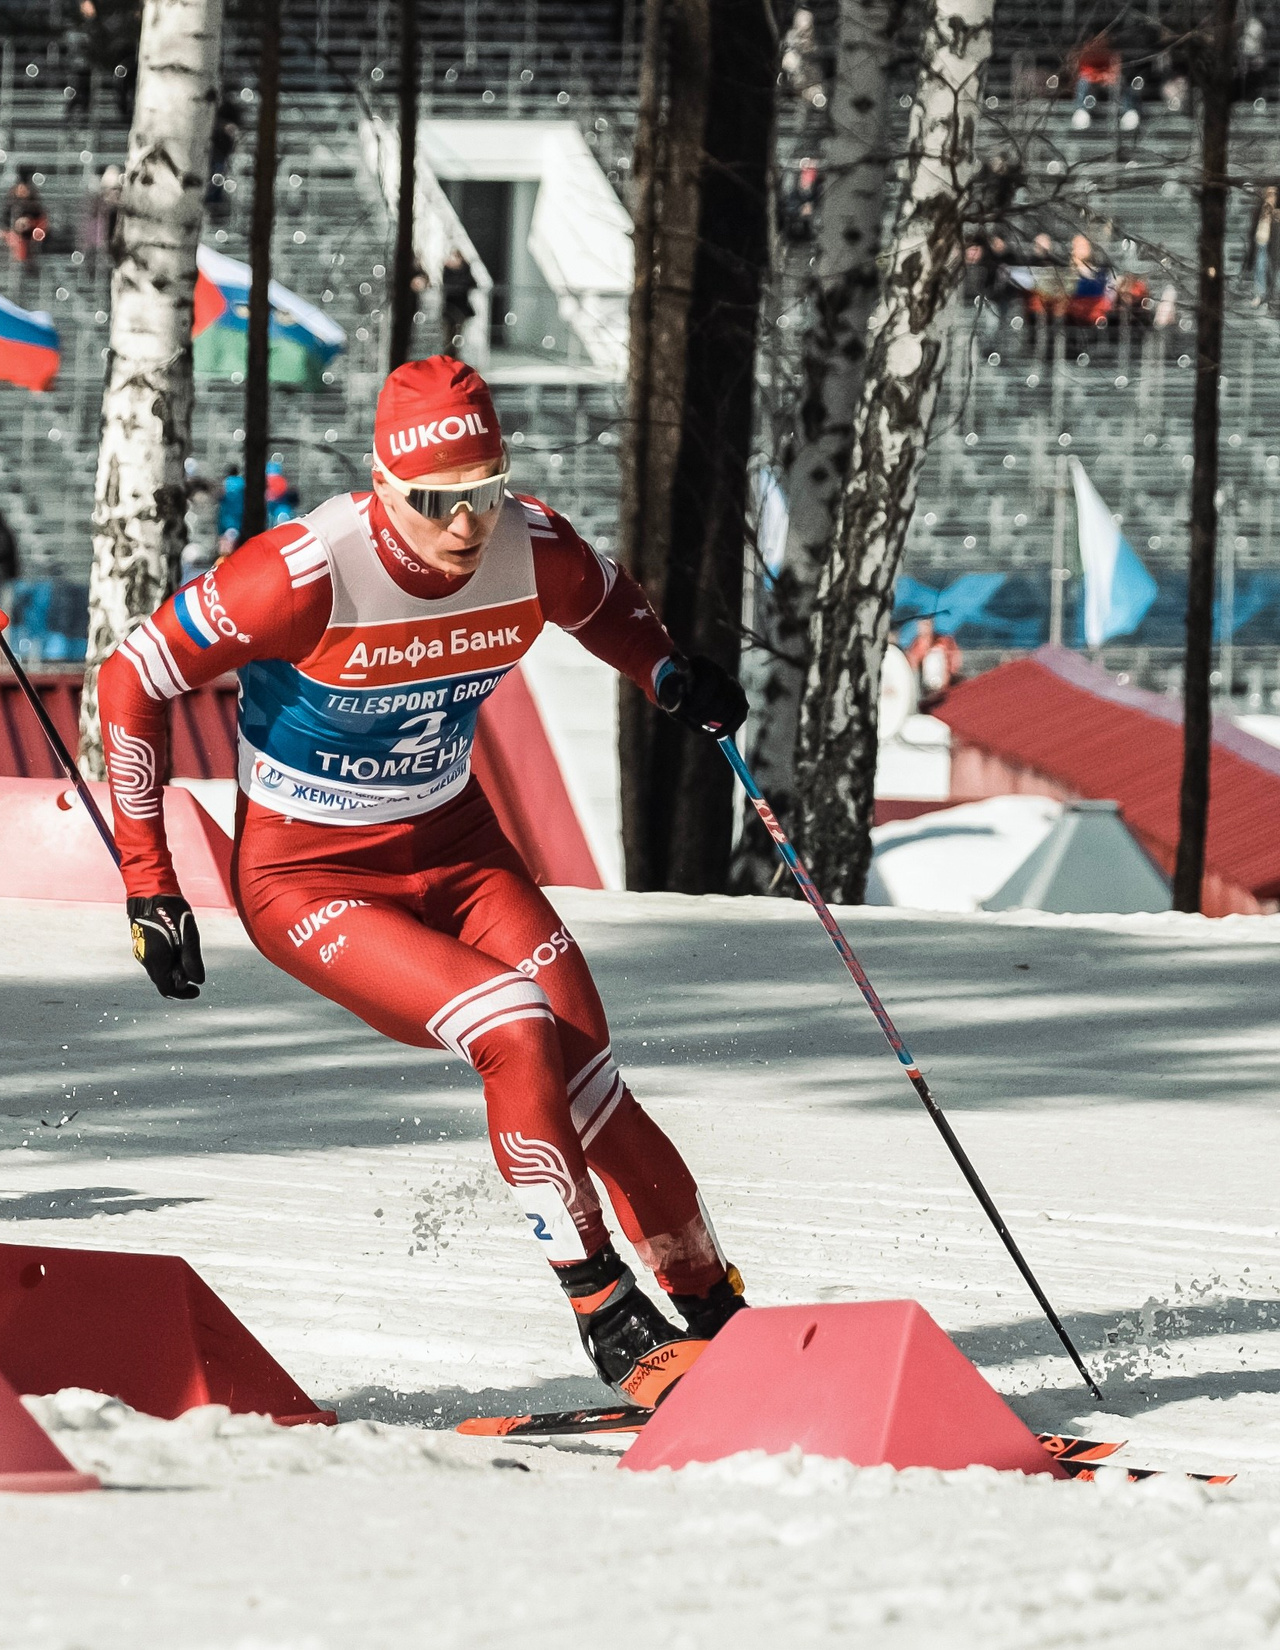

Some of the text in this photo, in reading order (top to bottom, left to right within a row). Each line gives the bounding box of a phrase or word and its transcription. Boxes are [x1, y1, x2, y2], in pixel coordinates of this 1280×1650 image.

[389, 412, 489, 457] LUKOIL
[380, 527, 421, 573] BOSCO
[339, 625, 522, 680] Альфа Банк
[326, 687, 449, 715] TELESPORT
[389, 710, 448, 754] 2
[314, 735, 469, 782] ТЮМЕНЬ
[524, 1212, 554, 1241] 2
